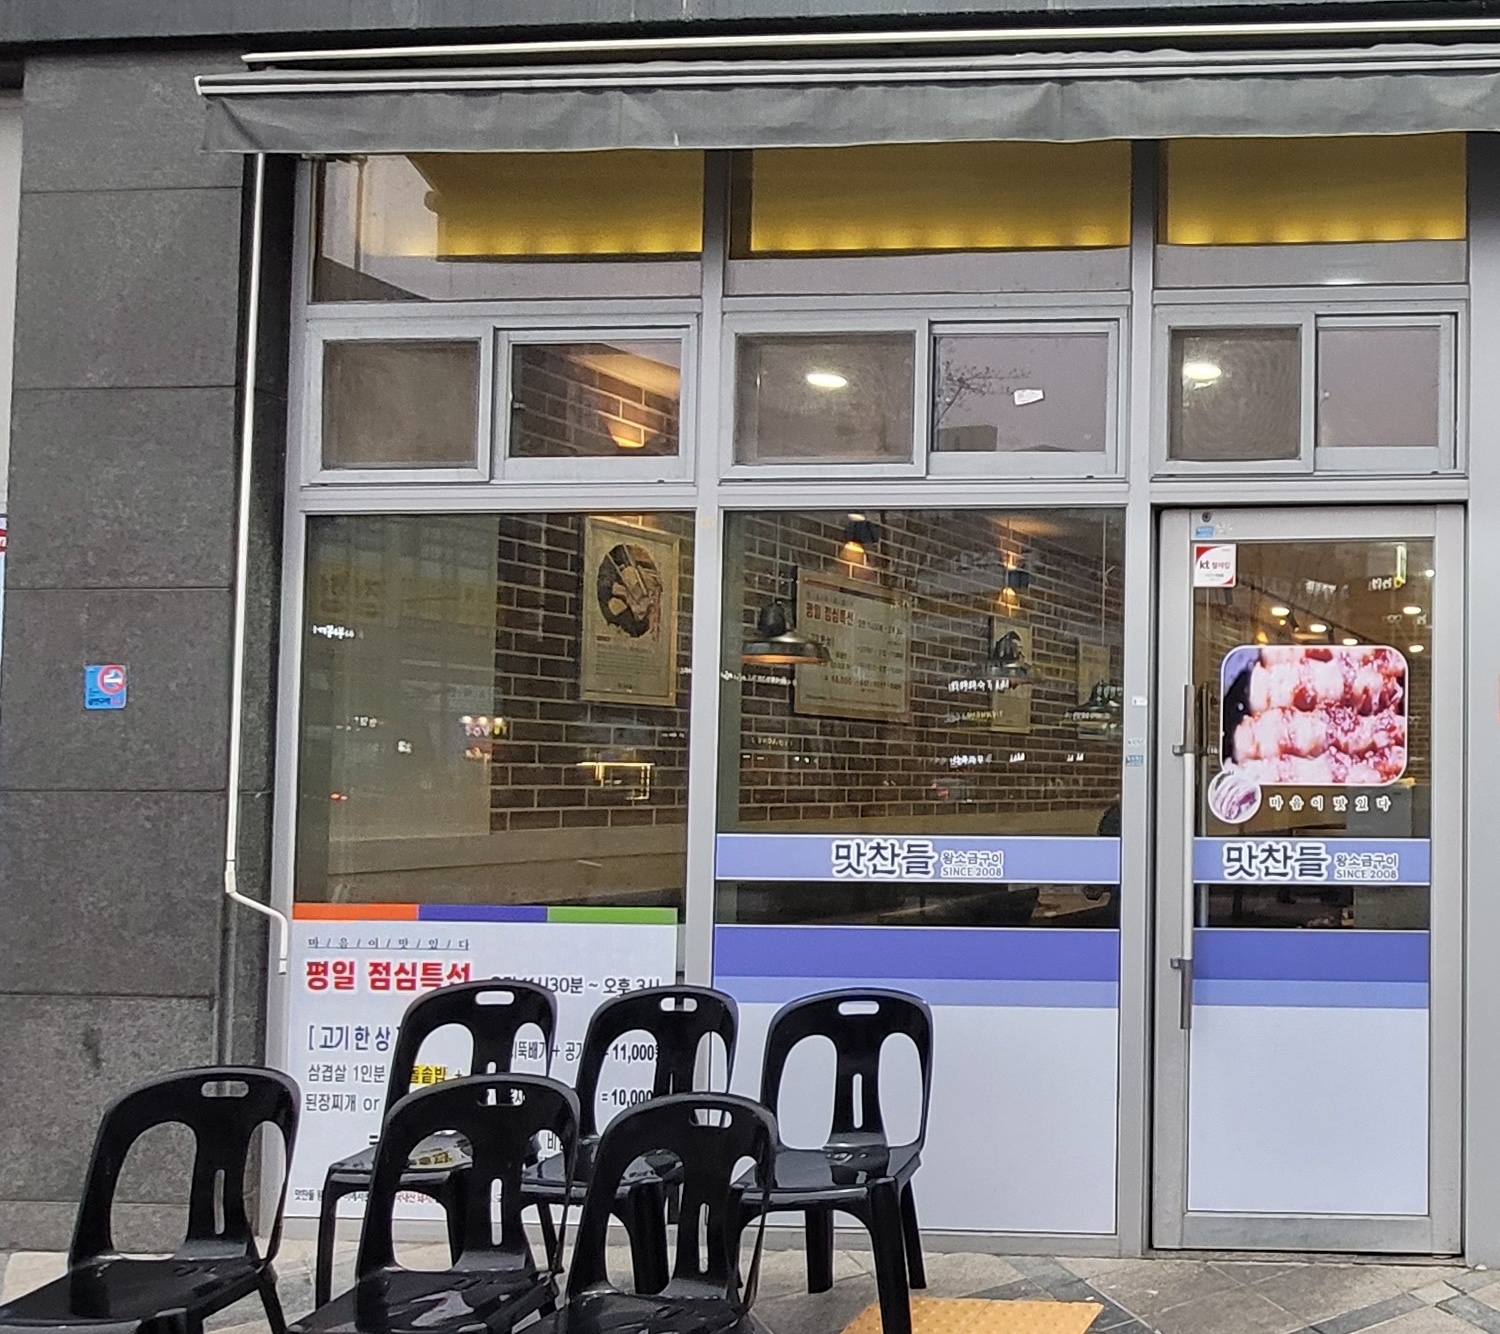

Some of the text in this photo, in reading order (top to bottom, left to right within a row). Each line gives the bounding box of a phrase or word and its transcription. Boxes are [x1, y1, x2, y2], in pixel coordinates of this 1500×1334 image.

[1200, 560, 1210, 569] kt
[833, 839, 1004, 878] 맛찬들 왕소금구이
[1223, 842, 1398, 880] 맛찬들 왕소금구이
[942, 867, 1003, 877] SINCE 2008
[1335, 869, 1398, 880] SINCE 2008
[306, 961, 355, 991] 평일
[368, 961, 471, 991] 점심특선
[613, 1043, 658, 1064] 11,000
[308, 1063, 347, 1082] 삼겹살
[353, 1064, 385, 1083] 1인분
[305, 1093, 380, 1112] 된장찌개 or
